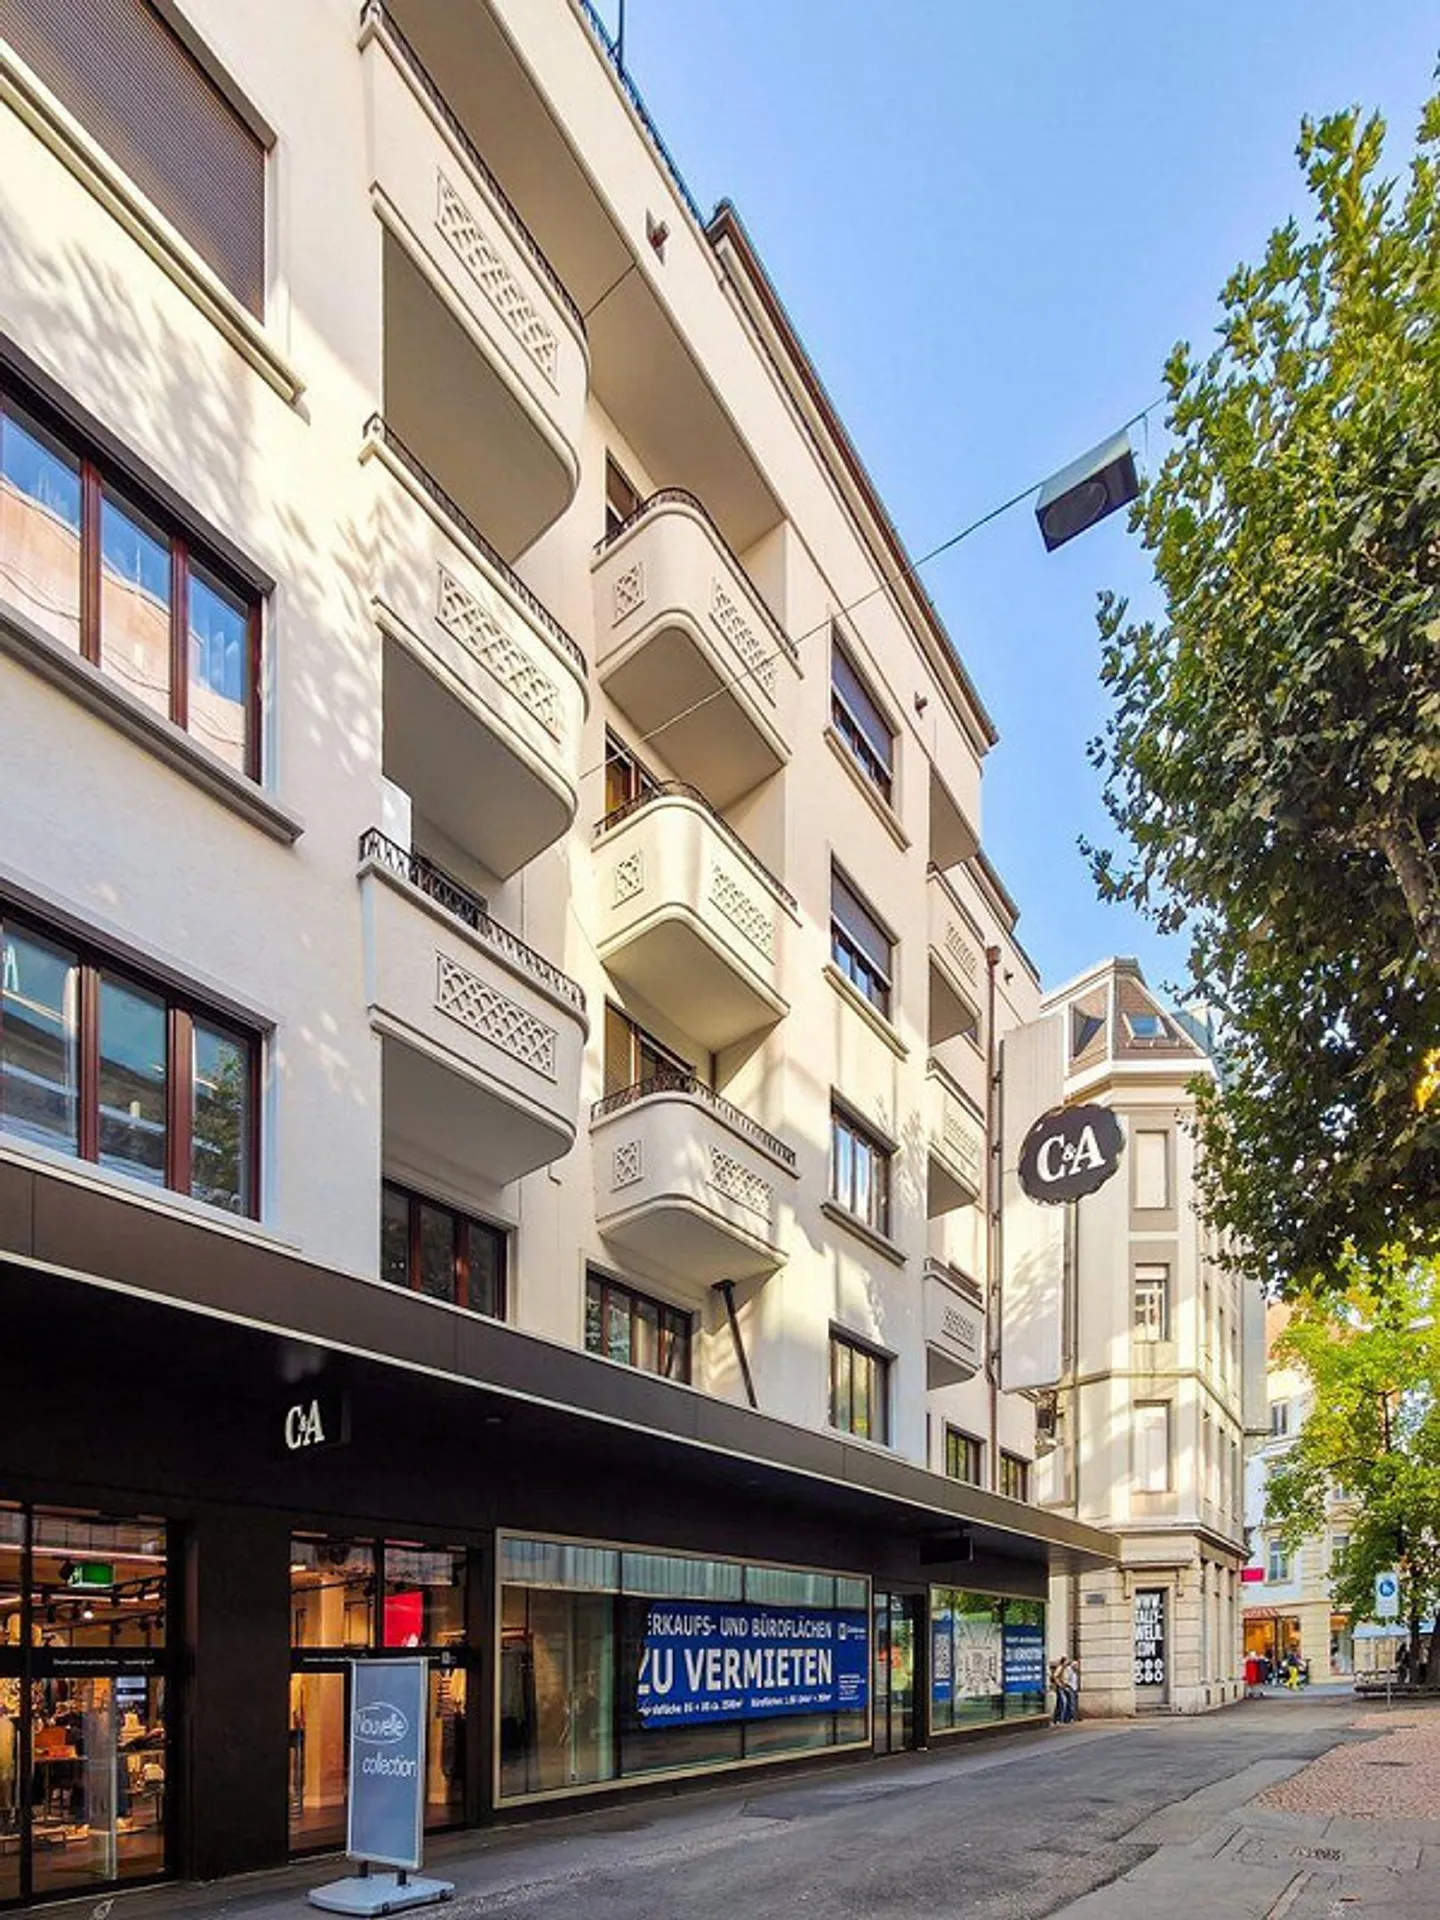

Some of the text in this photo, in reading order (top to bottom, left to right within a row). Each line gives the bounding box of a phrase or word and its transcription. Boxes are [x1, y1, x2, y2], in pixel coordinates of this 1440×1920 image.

[1036, 1124, 1107, 1182] C&A
[285, 1399, 326, 1450] C&A
[719, 1616, 749, 1636] UND
[751, 1612, 833, 1639] BÜROFLÄCHEN
[684, 1648, 833, 1692] VERMIETEN
[362, 1752, 417, 1778] collection
